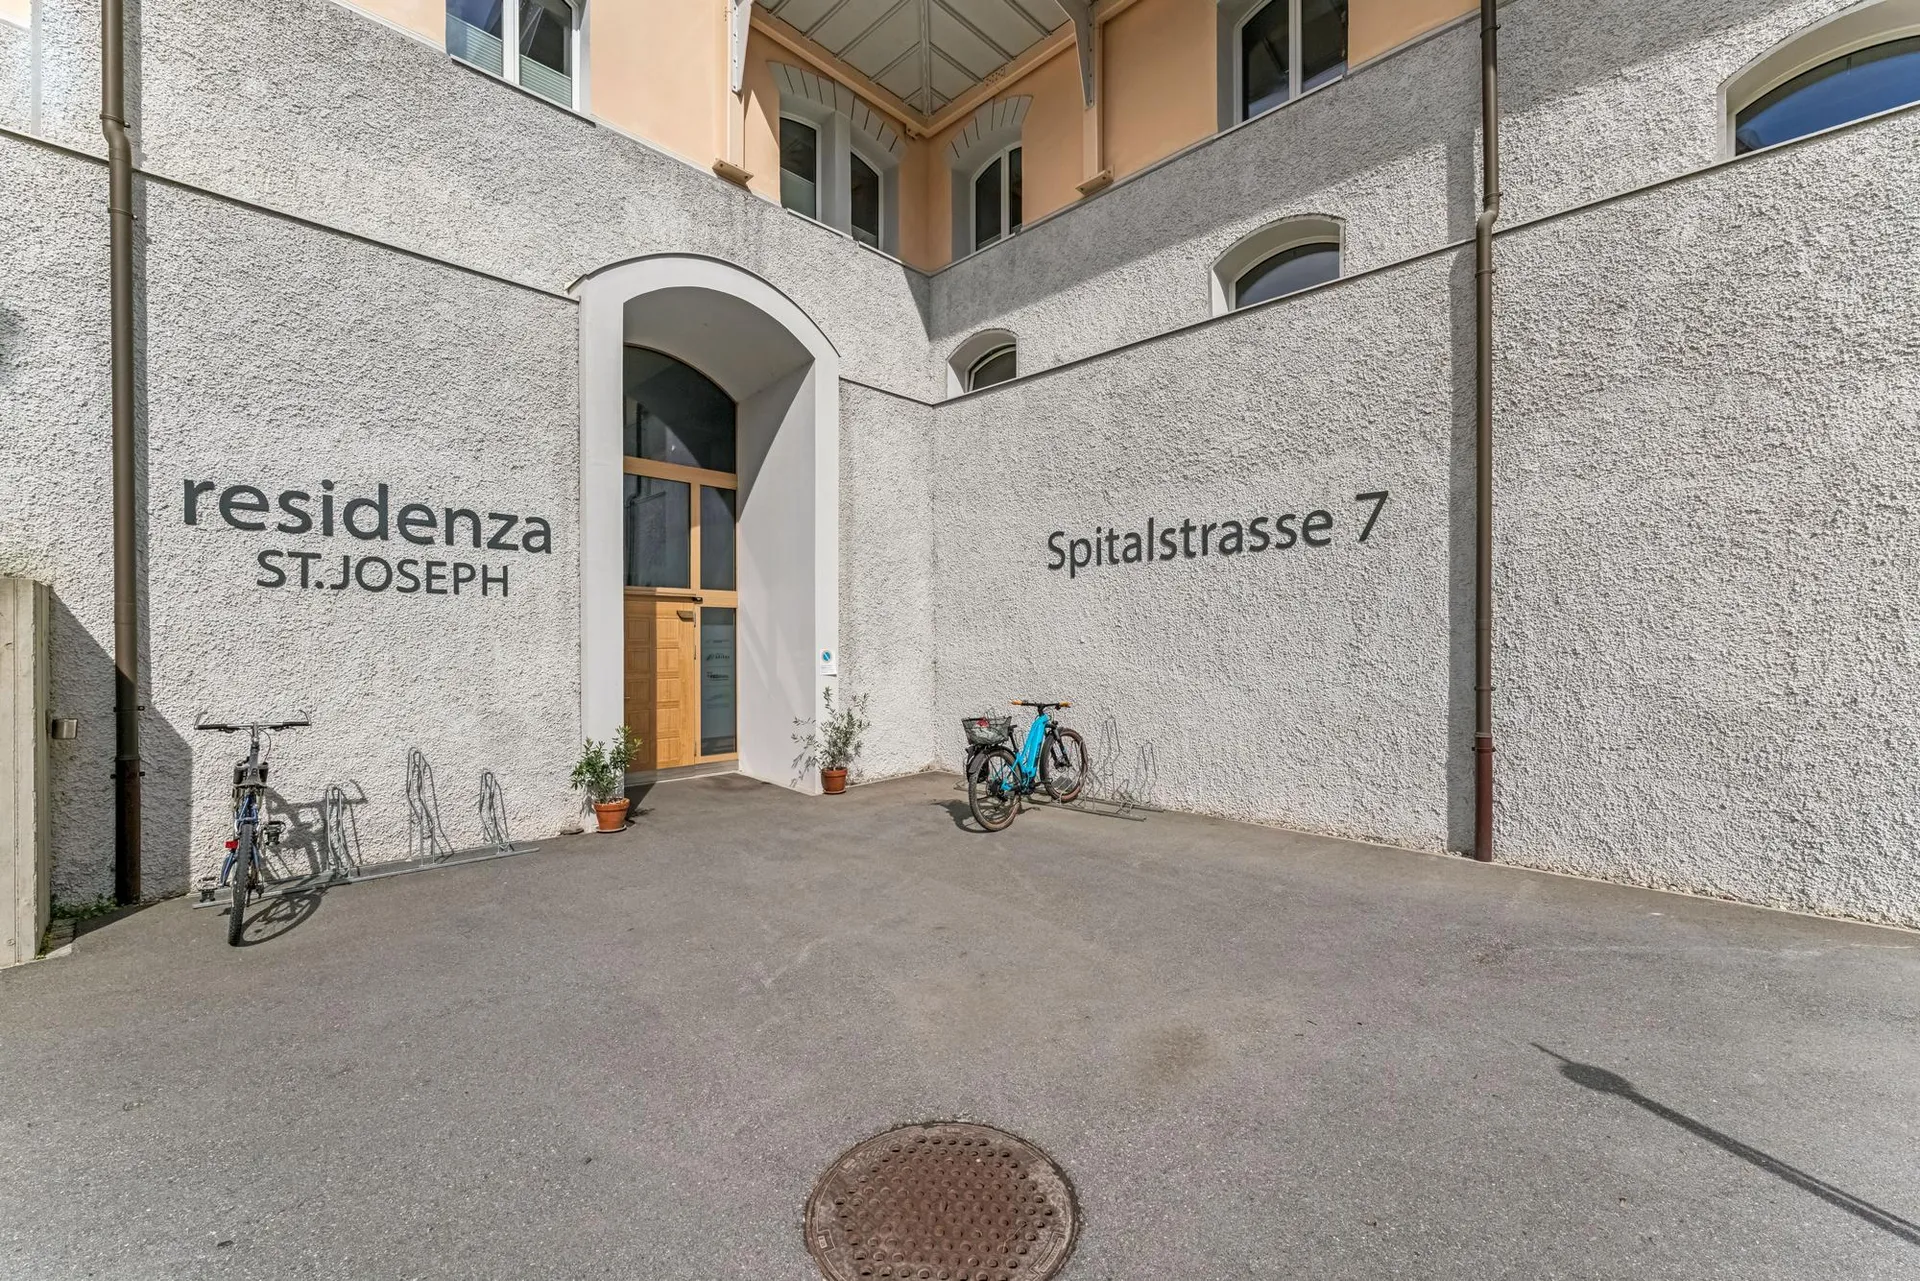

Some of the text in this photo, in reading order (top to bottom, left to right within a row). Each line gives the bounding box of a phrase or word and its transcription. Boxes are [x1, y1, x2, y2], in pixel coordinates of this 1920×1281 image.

[183, 478, 553, 555] residenza
[1047, 490, 1389, 579] Spitalstrasse 7
